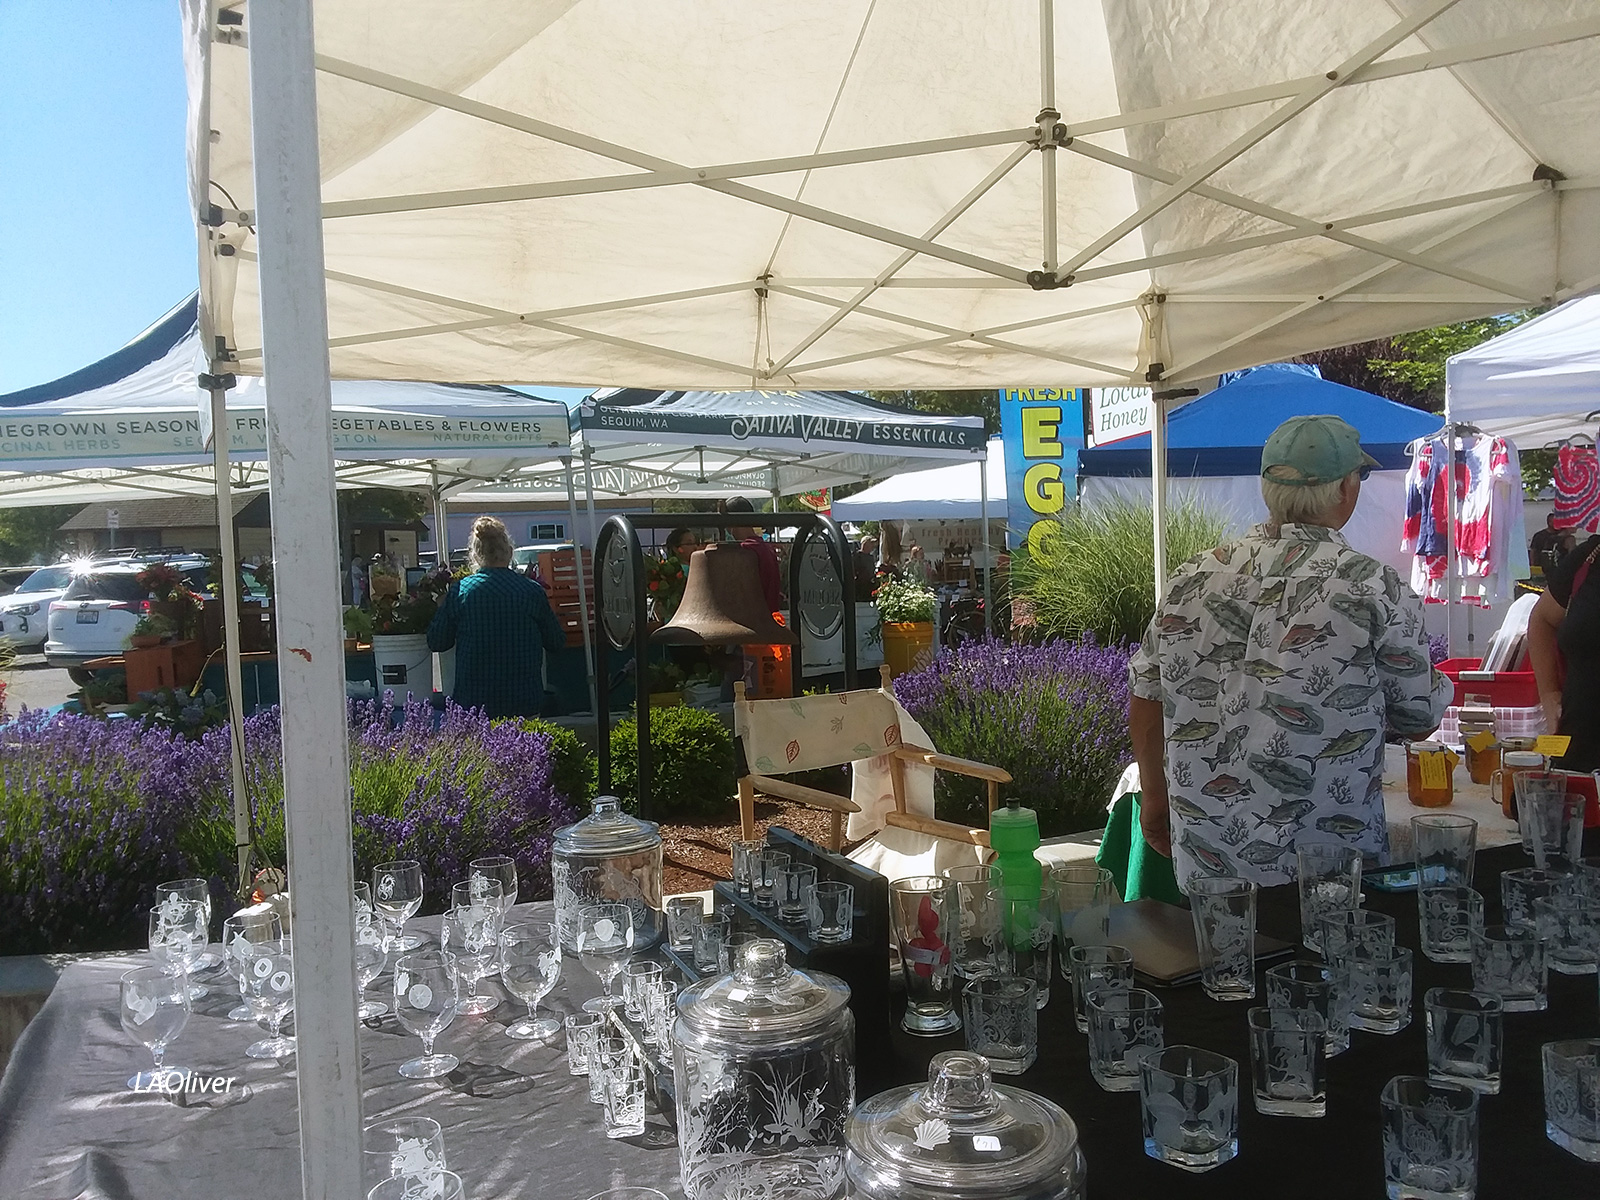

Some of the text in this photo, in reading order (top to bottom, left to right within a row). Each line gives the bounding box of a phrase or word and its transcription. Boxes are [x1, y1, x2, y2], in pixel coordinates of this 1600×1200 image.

[1005, 387, 1076, 401] FRESH
[0, 422, 106, 438] EGROWN
[117, 419, 229, 434] SEASON
[332, 418, 435, 431] EGETABLES
[441, 420, 451, 431] &
[459, 420, 542, 433] FLOWERS
[600, 415, 669, 428] SEQUIM, WA
[1100, 406, 1148, 432] Honey
[0, 441, 57, 453] CINAL
[63, 439, 121, 451] HERBS
[433, 433, 497, 442] NATURAL
[504, 434, 542, 442] GIFTS
[872, 423, 966, 446] ESSENTIALS
